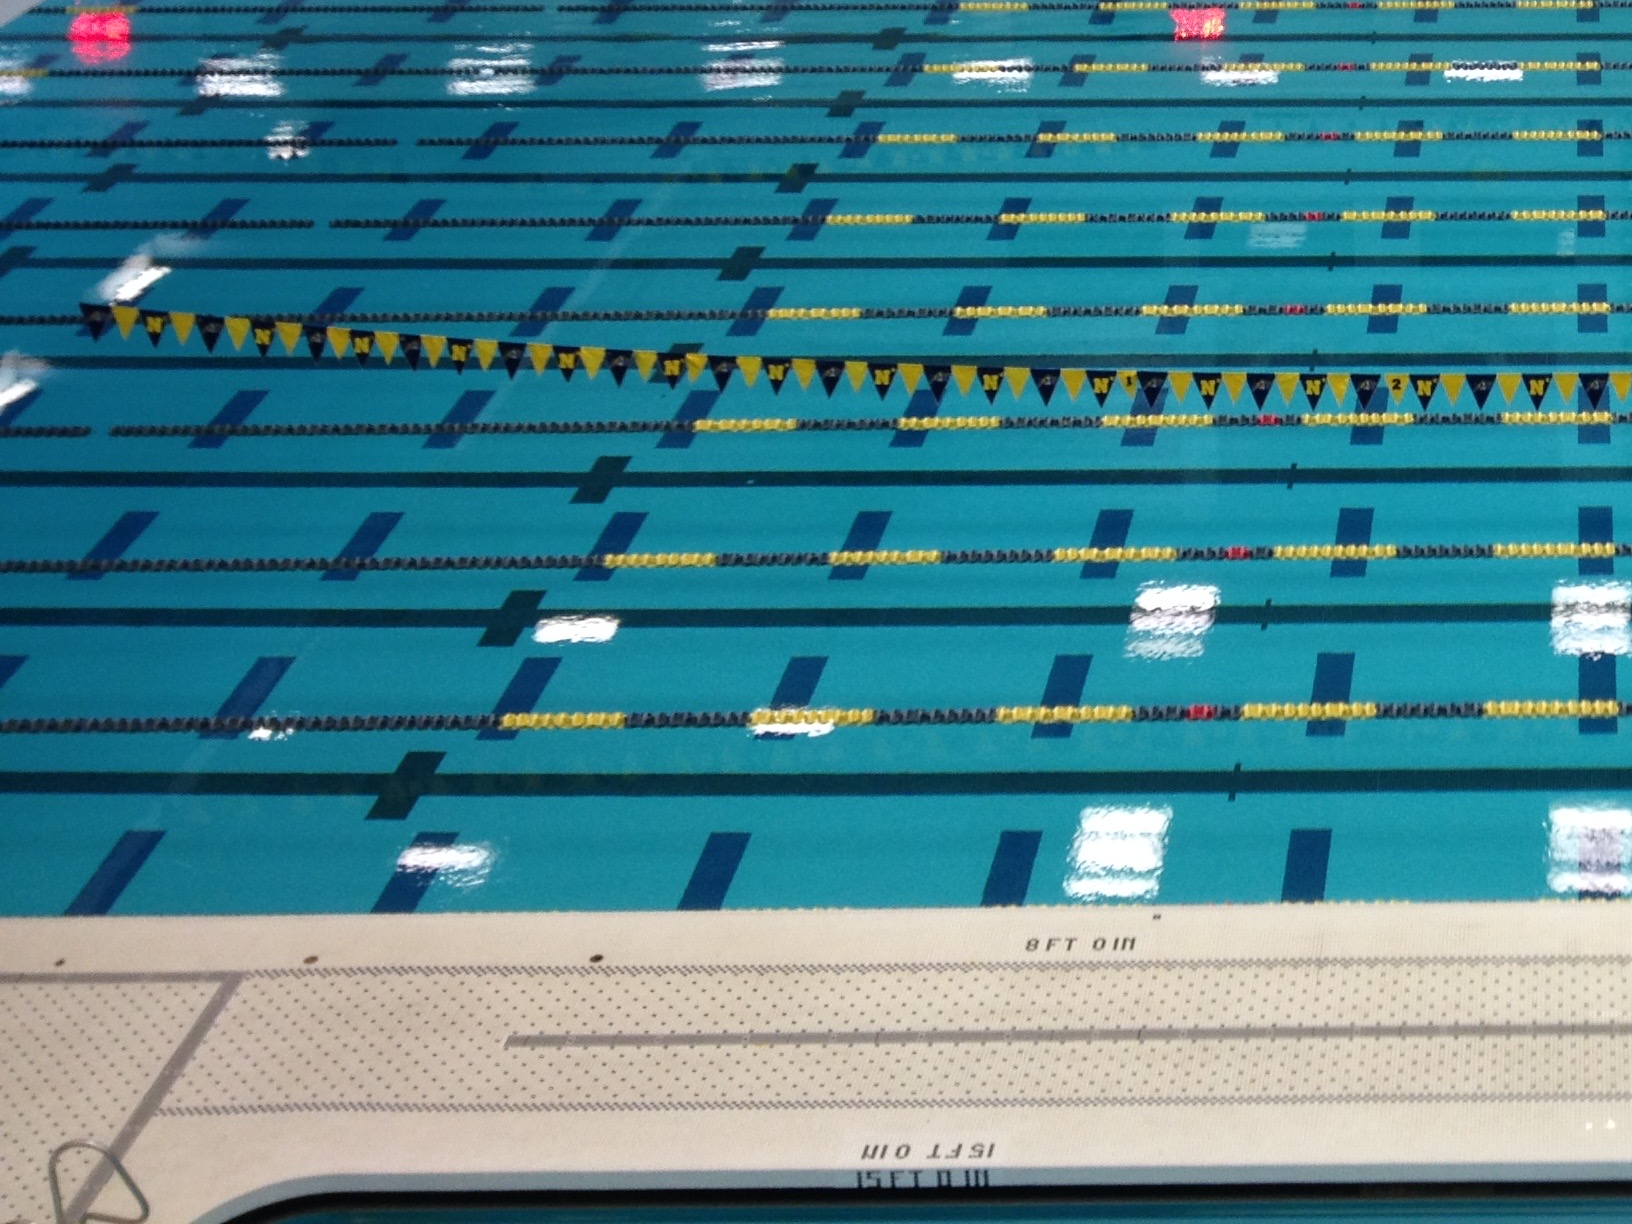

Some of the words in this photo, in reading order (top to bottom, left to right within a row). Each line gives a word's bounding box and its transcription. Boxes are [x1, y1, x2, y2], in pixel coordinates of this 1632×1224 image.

[146, 316, 164, 333] N
[255, 328, 270, 345] N
[354, 337, 370, 353] N
[452, 345, 467, 361] N
[559, 352, 575, 368] N
[664, 360, 680, 376] N
[769, 364, 784, 381] N
[875, 369, 890, 385] N
[983, 374, 999, 390] N
[1094, 377, 1110, 394] N
[1201, 380, 1215, 396] N
[1306, 379, 1321, 395] N
[1392, 378, 1401, 390] 2
[1417, 379, 1432, 395] N
[1530, 379, 1545, 395] N
[1025, 937, 1078, 952] 8FT
[926, 1142, 995, 1159] 15FT
